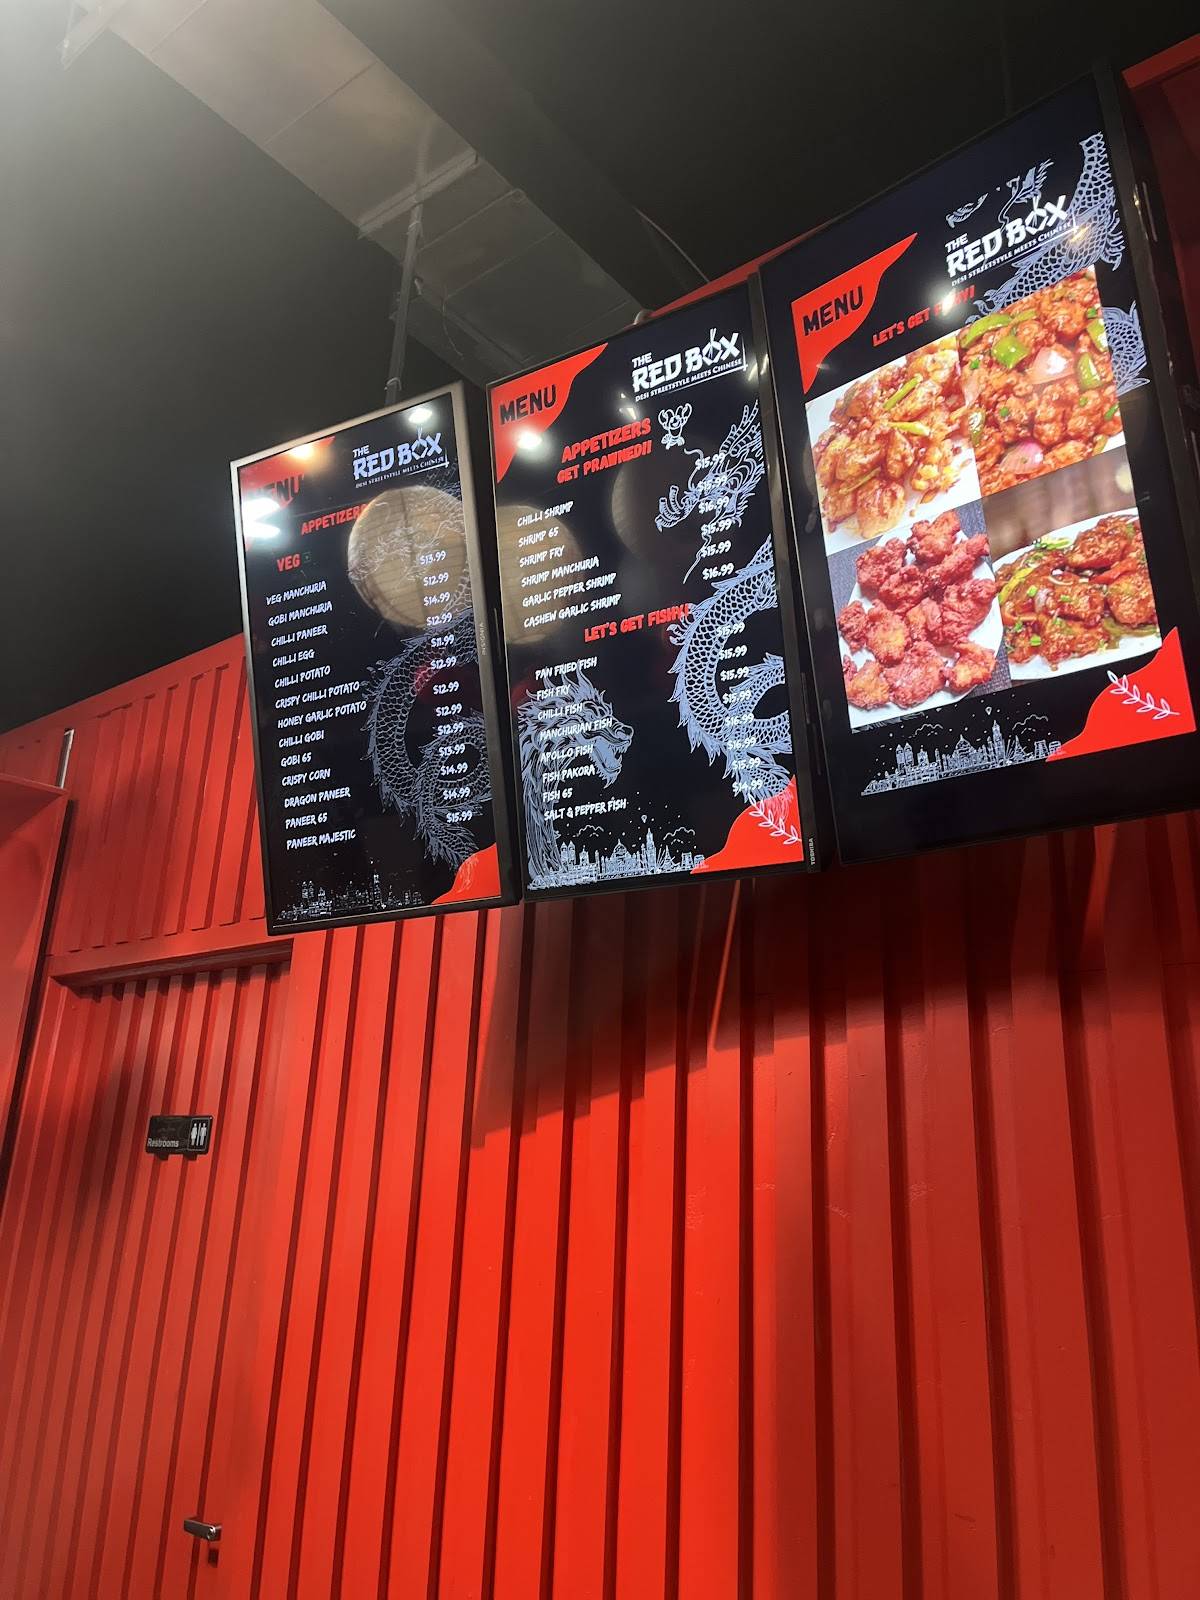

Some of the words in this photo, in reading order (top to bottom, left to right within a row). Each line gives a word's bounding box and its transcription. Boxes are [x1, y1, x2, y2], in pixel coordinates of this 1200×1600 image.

[945, 233, 968, 252] THE
[946, 228, 1002, 278] RED
[1005, 195, 1068, 247] BOX
[1013, 238, 1037, 256] MEETS
[802, 286, 864, 337] MENU
[872, 321, 905, 347] LET'S
[907, 307, 931, 329] GET
[632, 352, 652, 369] THE
[632, 353, 682, 393] RED
[685, 332, 740, 373] BOX
[635, 393, 649, 402] DESI
[650, 377, 690, 396] STREETSTYLE
[691, 369, 712, 381] MEETS
[712, 358, 742, 374] CHINESE
[500, 384, 557, 425] MENU
[561, 417, 652, 464] APPETIZERS
[352, 445, 370, 458] THE
[353, 448, 394, 480] RED
[397, 432, 443, 466] BOX
[556, 464, 580, 484] GET
[583, 440, 653, 476] PRAWNED!!
[695, 453, 725, 470] $15.99
[697, 475, 728, 493] $15.99
[517, 510, 543, 527] CHILLI
[544, 501, 574, 519] SHRIMP
[699, 496, 729, 514] $16.99
[701, 519, 732, 535] $15.99
[519, 530, 546, 547] SHRIMP
[548, 526, 559, 538] 65
[519, 550, 547, 567] SHRIMP
[549, 545, 565, 559] FRY
[700, 540, 731, 558] $15.99
[277, 553, 300, 572] VEG
[521, 570, 550, 587] SHRIMP
[552, 556, 600, 579] MANCHURIA
[702, 562, 734, 580] $16.99
[423, 572, 449, 586] $12.99
[266, 594, 282, 605] VEG
[283, 580, 327, 601] MANCHURIA
[522, 591, 552, 607] GARLIC
[553, 581, 585, 600] PEPPER
[585, 572, 617, 591] SHRIMP
[423, 592, 450, 606] $14.99
[268, 614, 287, 626] GOBI
[289, 601, 333, 622] MANCHURIA
[426, 612, 452, 626] $12.99
[524, 610, 557, 628] CASHEW
[558, 602, 589, 620] GARLIC
[590, 593, 621, 611] SHRIMP
[271, 633, 295, 647] CHILLI
[296, 625, 328, 641] PANEER
[584, 621, 617, 642] LET'S
[620, 614, 645, 633] GET
[716, 622, 745, 637] $15.99
[431, 634, 454, 647] $11.99
[272, 653, 296, 667] CHILLI
[298, 649, 315, 661] EGG
[718, 645, 747, 660] $15.99
[430, 656, 457, 670] $12.99
[535, 667, 553, 680] PAN
[554, 662, 577, 676] FRIED
[579, 656, 597, 670] FISH
[274, 674, 299, 689] CHILLI
[300, 665, 331, 683] POTATO
[720, 666, 749, 682] $15.99
[275, 695, 301, 709] CRISPY
[302, 689, 327, 703] CHILLI
[328, 681, 360, 698] POTATO
[433, 681, 459, 695] $12.99
[537, 688, 553, 700] FISH
[556, 684, 571, 696] FRY
[722, 690, 751, 705] $15.99
[277, 715, 304, 729] HONEY
[305, 708, 334, 723] GARLIC
[335, 701, 367, 717] POTATO
[435, 703, 462, 717] $12.99
[537, 707, 563, 720] CHILLI
[564, 703, 583, 715] FISH
[437, 722, 464, 735] $12.99
[540, 721, 592, 740] MANCHURIAN
[594, 718, 613, 730] FISH
[724, 713, 754, 727] $16.99
[279, 735, 303, 748] CHILLI
[304, 730, 325, 743] GOBI
[727, 737, 757, 750] $16.99
[281, 755, 300, 767] GOBI
[302, 752, 312, 763] 65
[540, 748, 573, 762] APOLLO
[575, 744, 594, 757] FISH
[282, 772, 307, 786] CRISPY
[309, 768, 331, 781] CORN
[440, 762, 468, 776] $14.99
[542, 771, 560, 783] FISH
[561, 764, 595, 780] PAKORA
[284, 793, 317, 808] DRAGON
[319, 787, 351, 803] PANEER
[542, 790, 560, 802] FISH
[562, 788, 573, 799] 65
[446, 810, 473, 823] $15.99
[544, 807, 565, 821] SALT
[566, 807, 574, 818] &
[574, 802, 607, 817] PEPPER
[607, 798, 627, 812] FISH
[285, 815, 317, 830] PANEER
[318, 812, 328, 823] 65
[287, 835, 318, 850] PANEER
[319, 829, 356, 845] MAJESTIC
[147, 1138, 179, 1148] Restrooms
